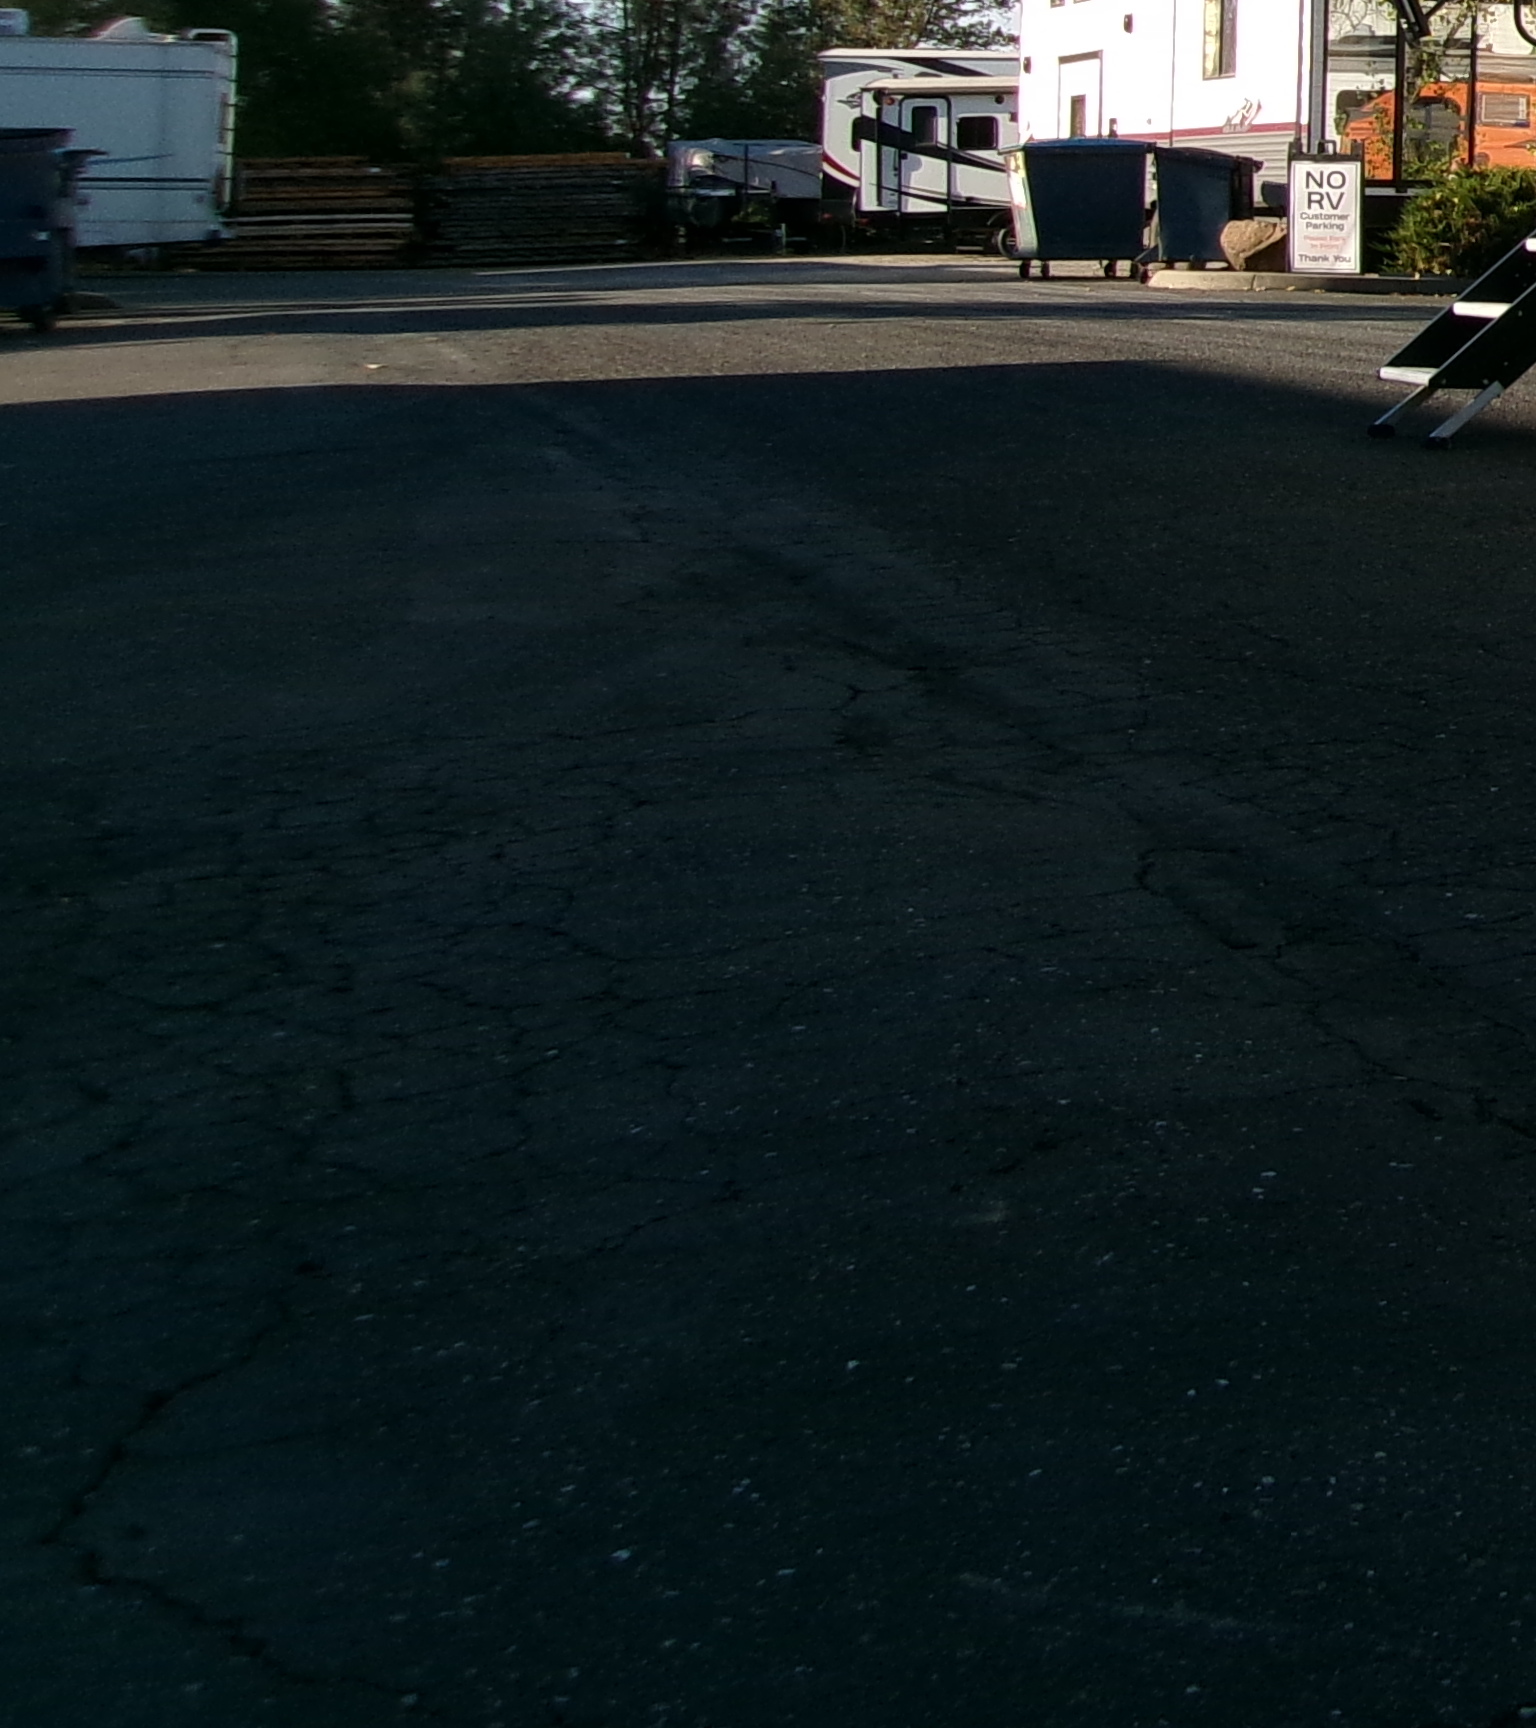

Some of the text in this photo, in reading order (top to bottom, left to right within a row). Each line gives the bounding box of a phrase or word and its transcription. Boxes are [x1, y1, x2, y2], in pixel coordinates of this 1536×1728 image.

[1305, 170, 1346, 190] NO
[1307, 191, 1345, 210] RV
[1299, 211, 1350, 221] Customer
[1305, 221, 1345, 232] Parking
[1298, 253, 1352, 263] Thank You
